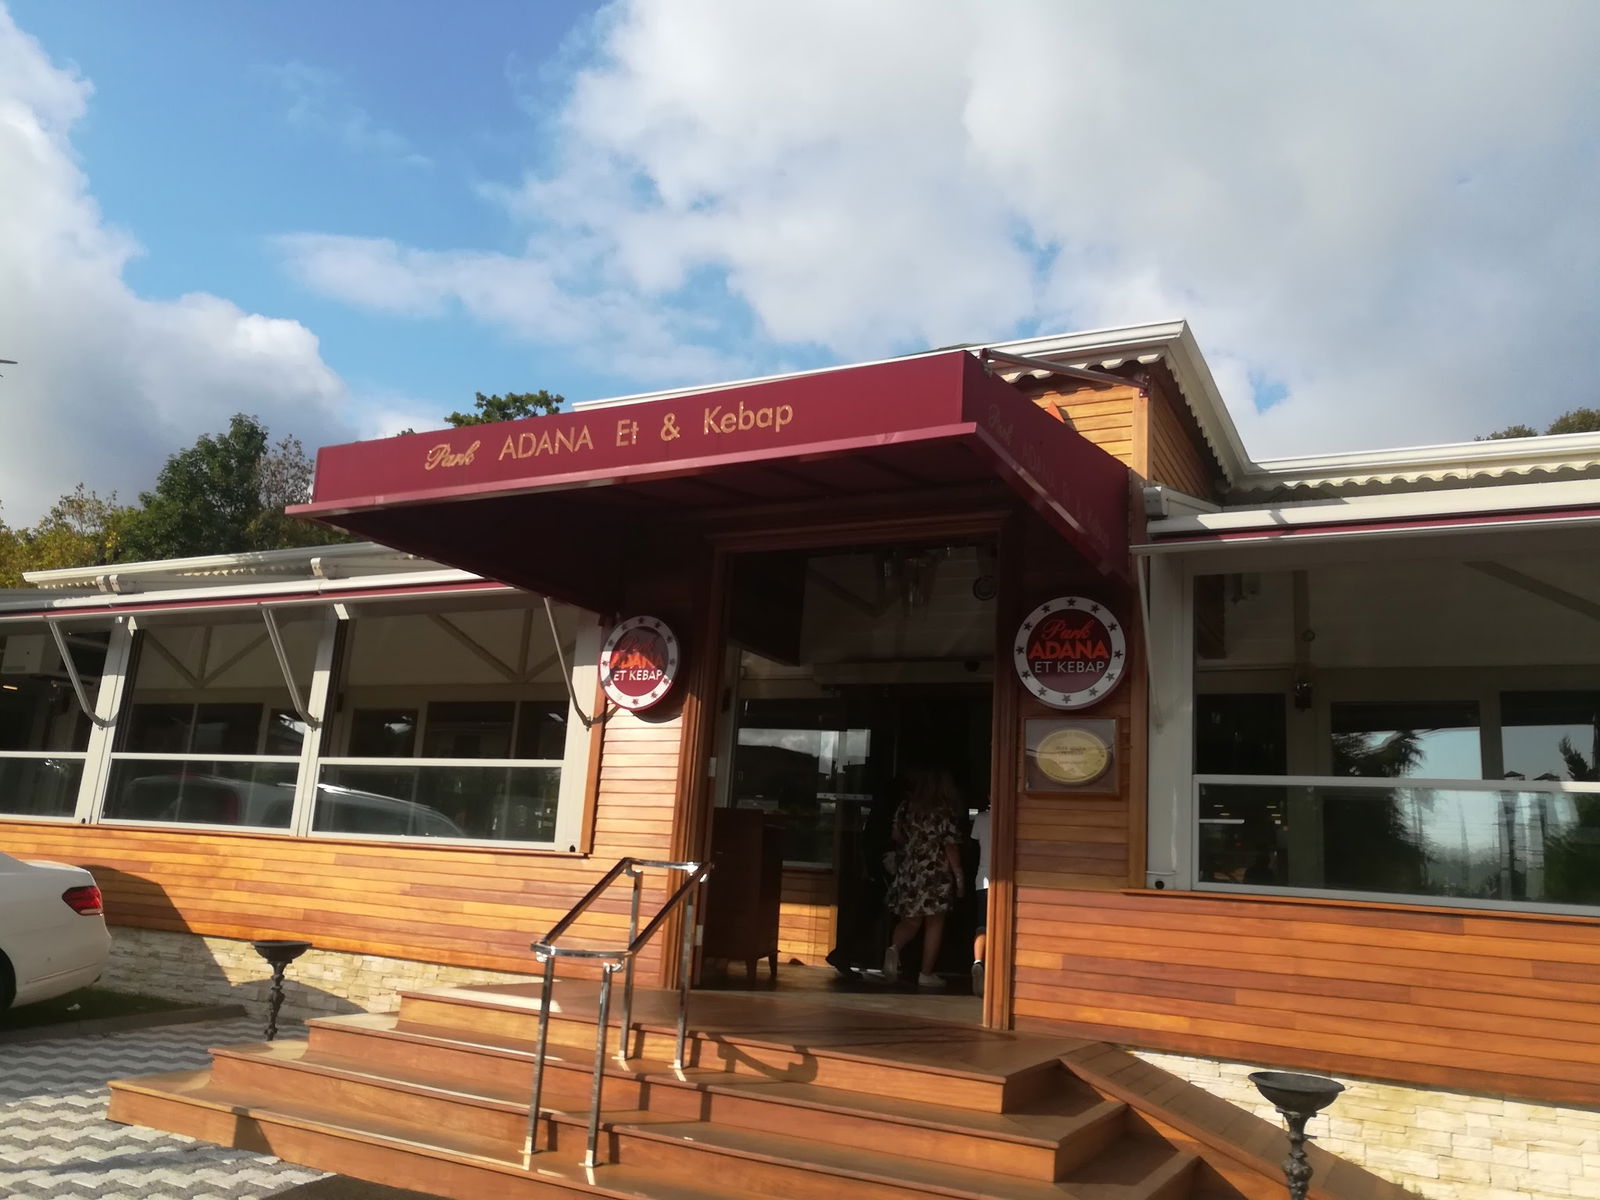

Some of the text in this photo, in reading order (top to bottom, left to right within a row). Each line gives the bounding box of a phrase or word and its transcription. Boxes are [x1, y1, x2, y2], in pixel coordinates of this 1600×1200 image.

[424, 401, 794, 471] Park ADANA Et & Kebap
[1040, 619, 1096, 640] Park
[1028, 639, 1110, 659] ADANA
[613, 669, 663, 681] ET KEBAP
[1034, 661, 1105, 673] ET KEBAP
